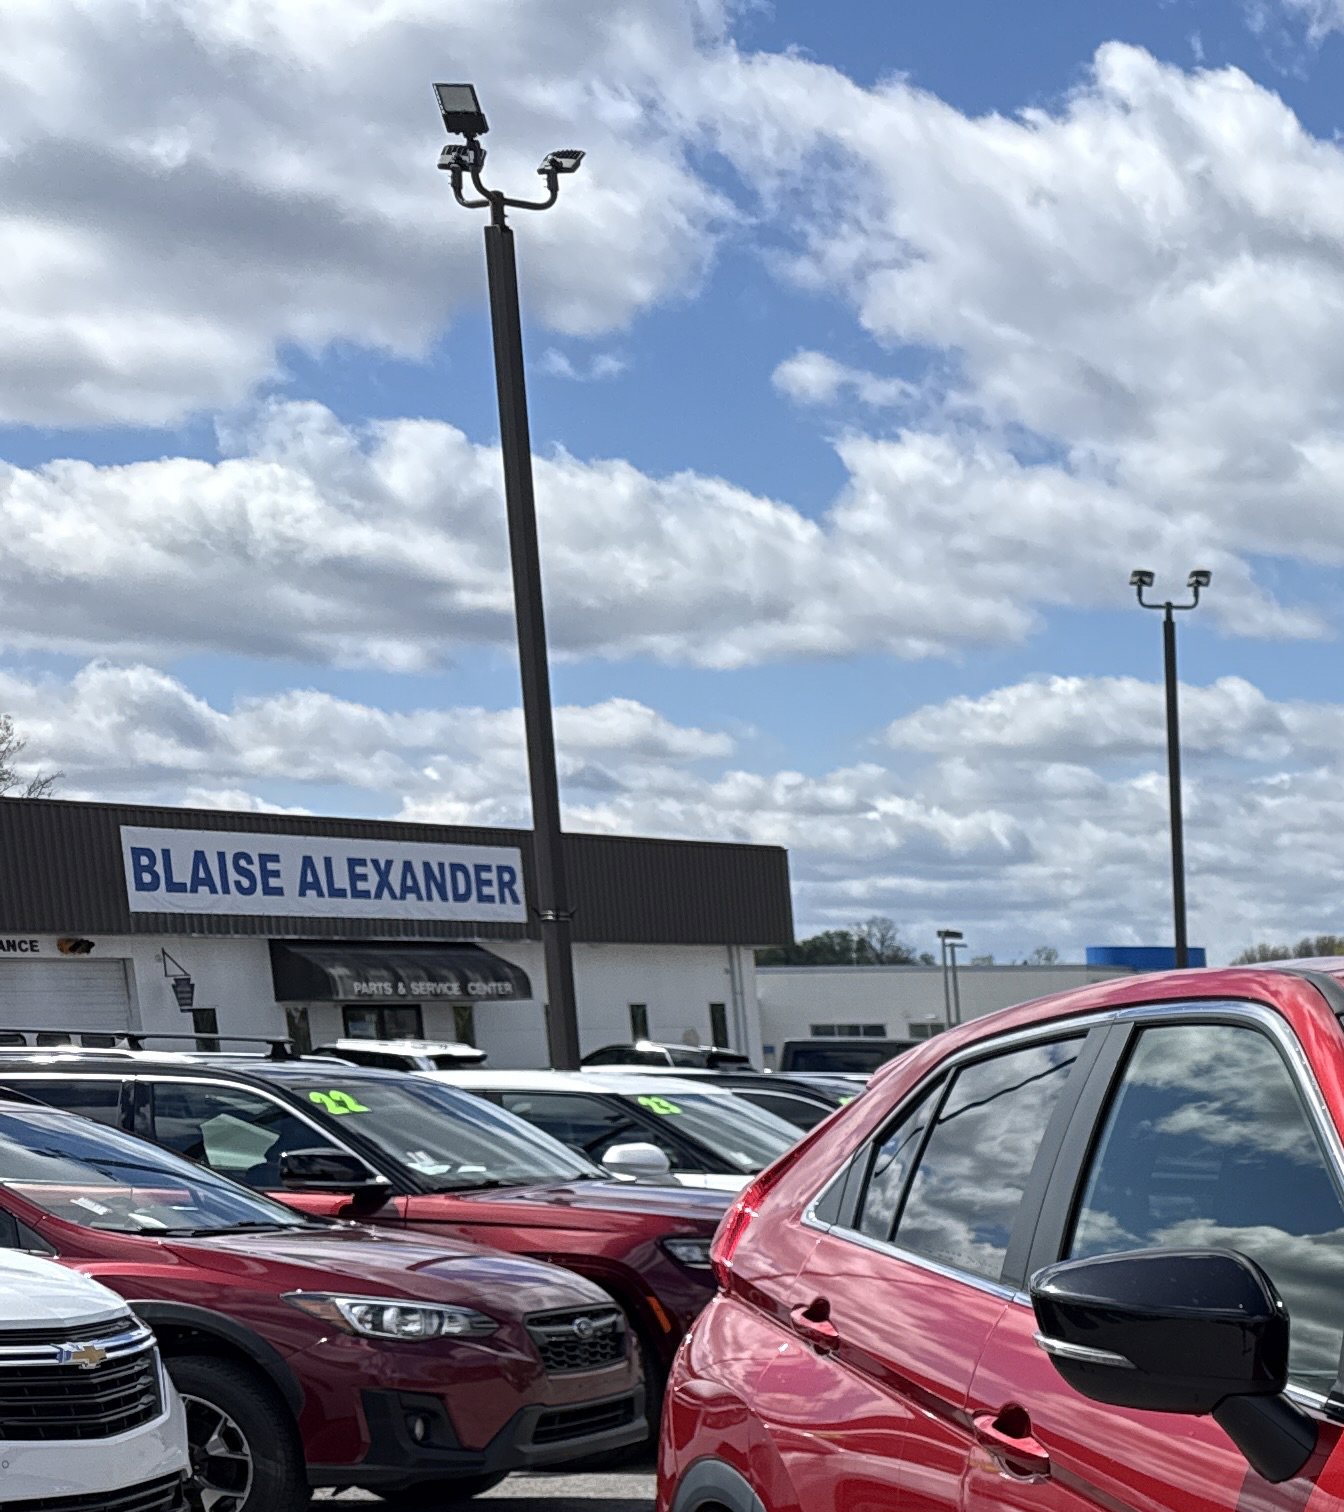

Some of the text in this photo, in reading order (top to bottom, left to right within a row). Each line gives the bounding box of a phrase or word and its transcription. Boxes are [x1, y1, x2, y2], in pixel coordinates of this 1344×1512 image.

[130, 846, 521, 905] BLAISE ALEXANDER
[353, 982, 514, 995] PARTS & SERVICE CENTER
[309, 1090, 372, 1115] 22
